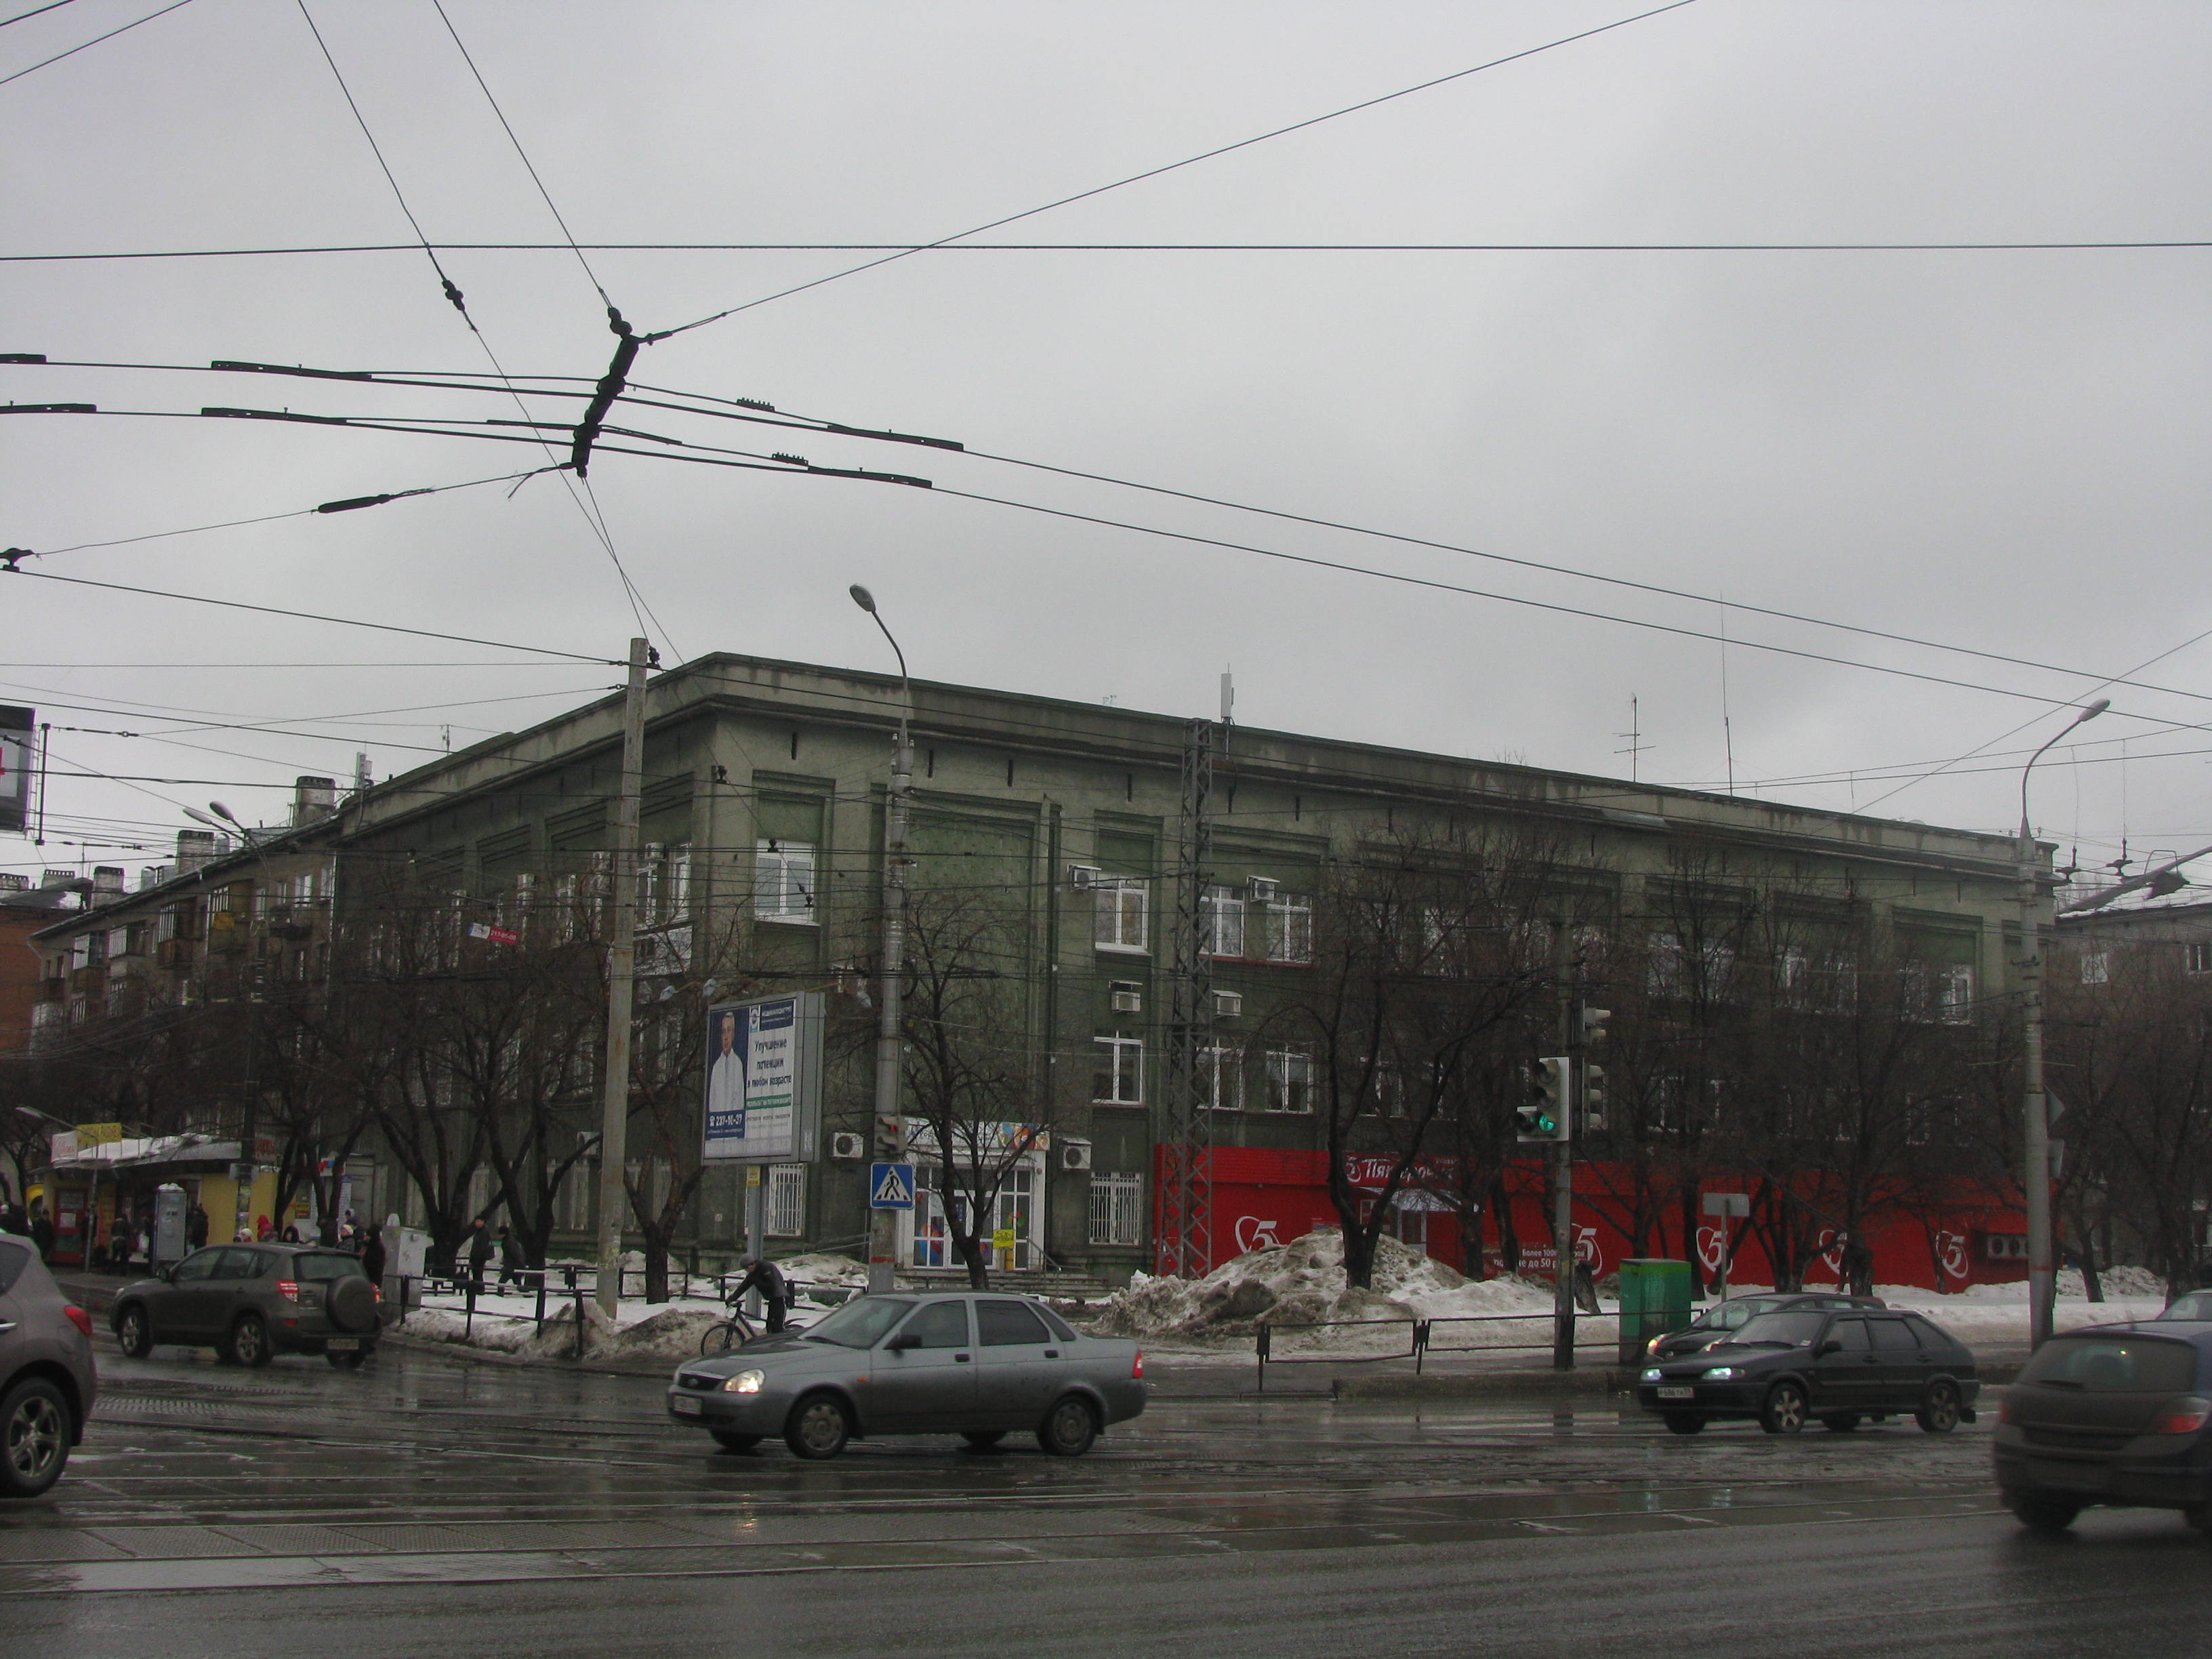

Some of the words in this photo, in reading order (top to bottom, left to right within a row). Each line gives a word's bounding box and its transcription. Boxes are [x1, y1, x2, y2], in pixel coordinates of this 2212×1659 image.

[1522, 1248, 1542, 1256] Более
[1528, 1260, 1539, 1269] до
[1540, 1258, 1551, 1267] 50
